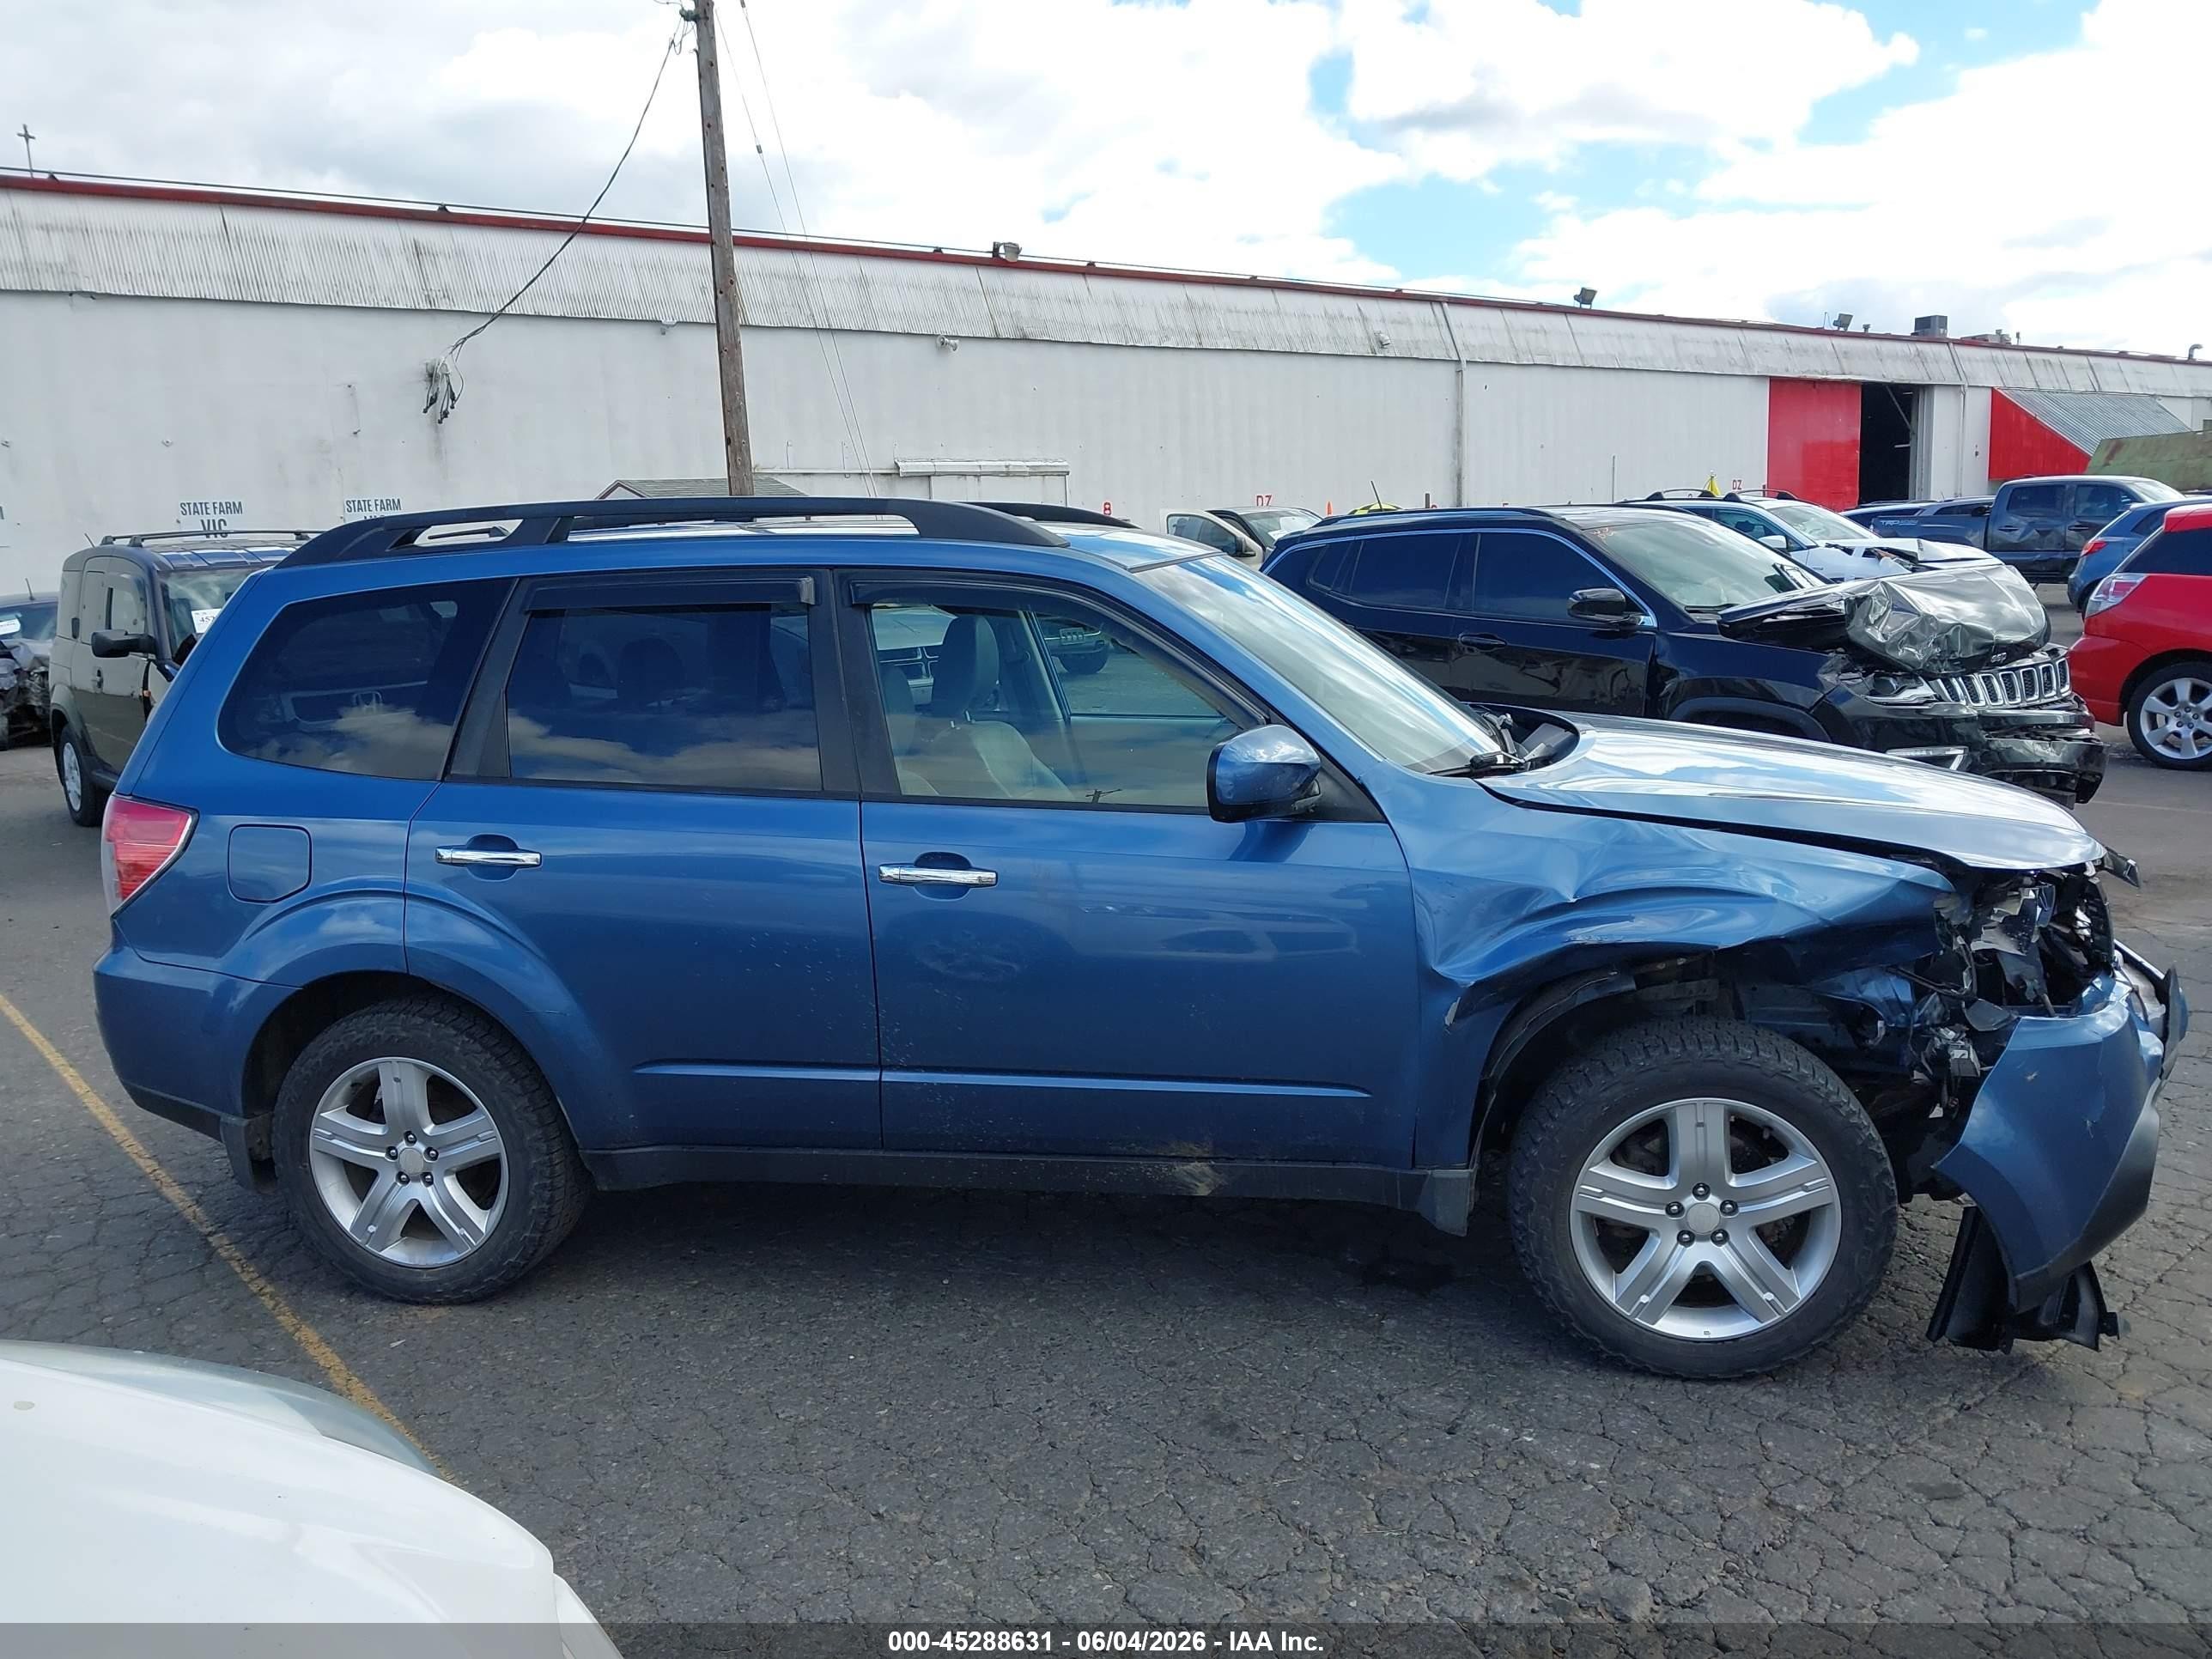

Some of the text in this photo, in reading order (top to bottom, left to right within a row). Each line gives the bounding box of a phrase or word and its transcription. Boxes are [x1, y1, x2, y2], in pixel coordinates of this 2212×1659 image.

[1732, 479, 1742, 490] DZ
[179, 501, 243, 516] STATE FARM
[346, 498, 402, 514] STATE FARM
[200, 519, 228, 538] VIC
